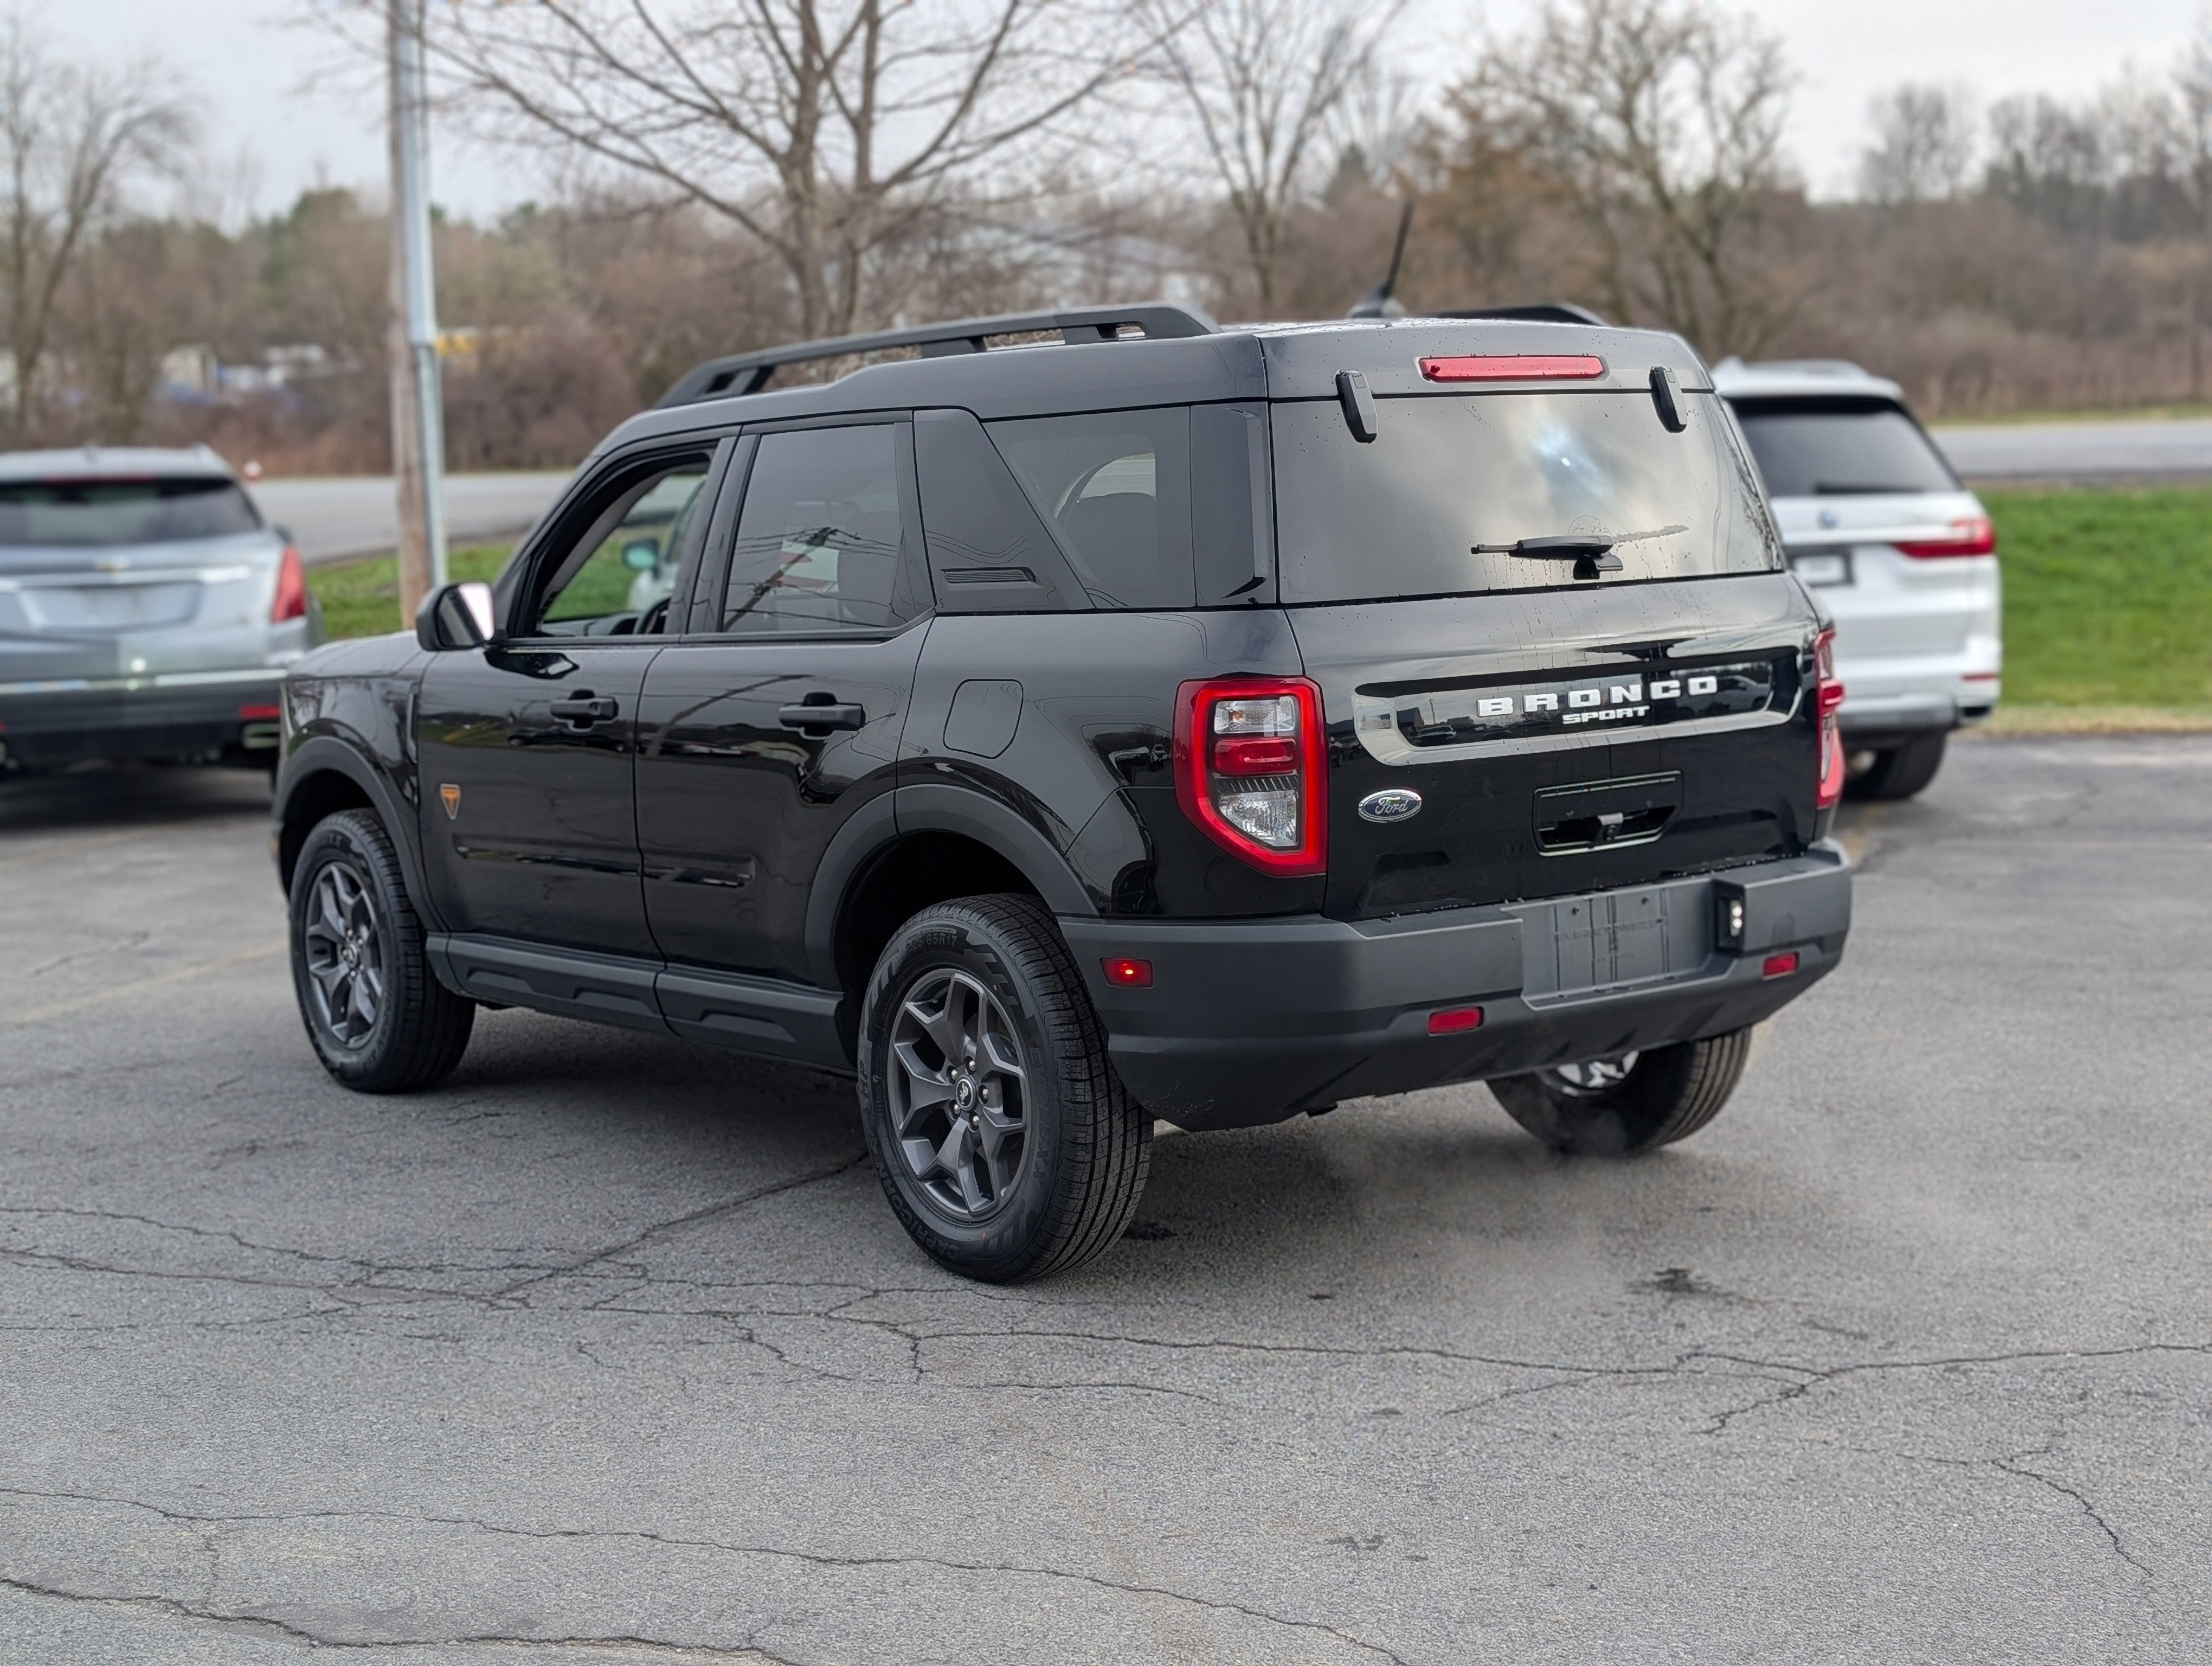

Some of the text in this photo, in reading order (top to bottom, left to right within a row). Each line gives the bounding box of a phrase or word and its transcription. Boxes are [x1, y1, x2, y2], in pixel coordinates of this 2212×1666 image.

[1477, 676, 1718, 717] BRONCO
[1562, 706, 1650, 724] SPORT
[1374, 797, 1409, 815] Ford
[876, 1162, 959, 1260] CAPRICORN
